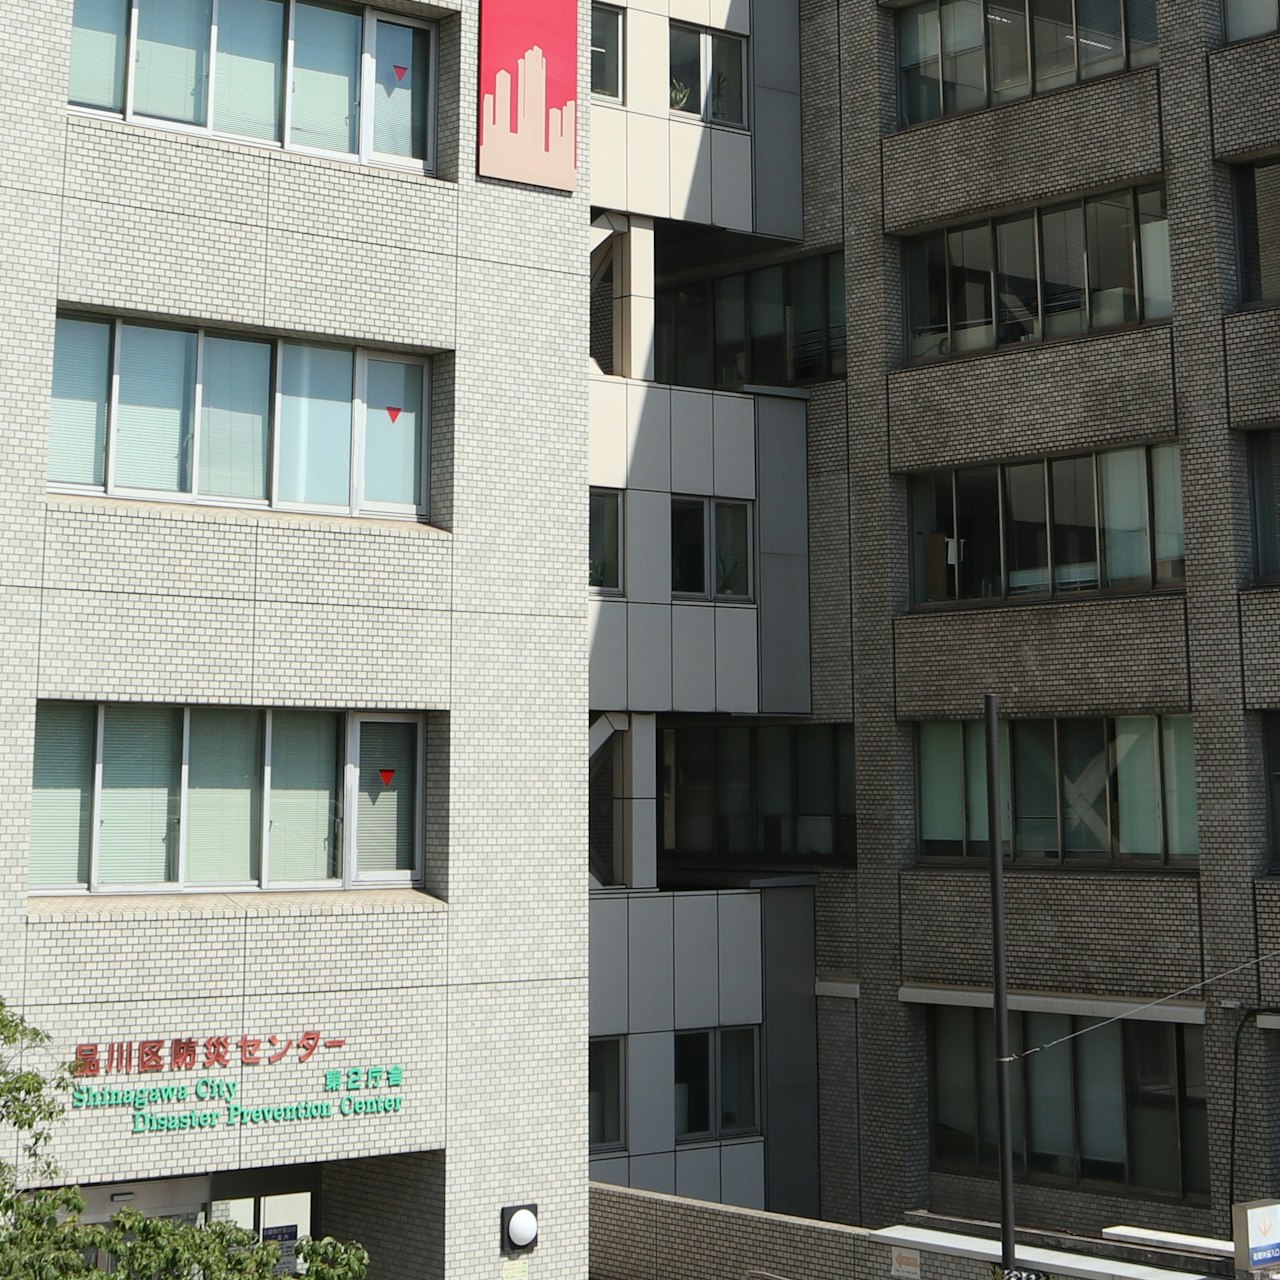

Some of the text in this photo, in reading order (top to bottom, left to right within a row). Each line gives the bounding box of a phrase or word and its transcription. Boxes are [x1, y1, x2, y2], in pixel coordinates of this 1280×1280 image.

[73, 1031, 345, 1076] 品川区防災センター
[72, 1077, 238, 1109] Shinagawa City
[325, 1065, 403, 1091] 第2庁舎
[132, 1095, 403, 1133] Disaster Prevention Center
